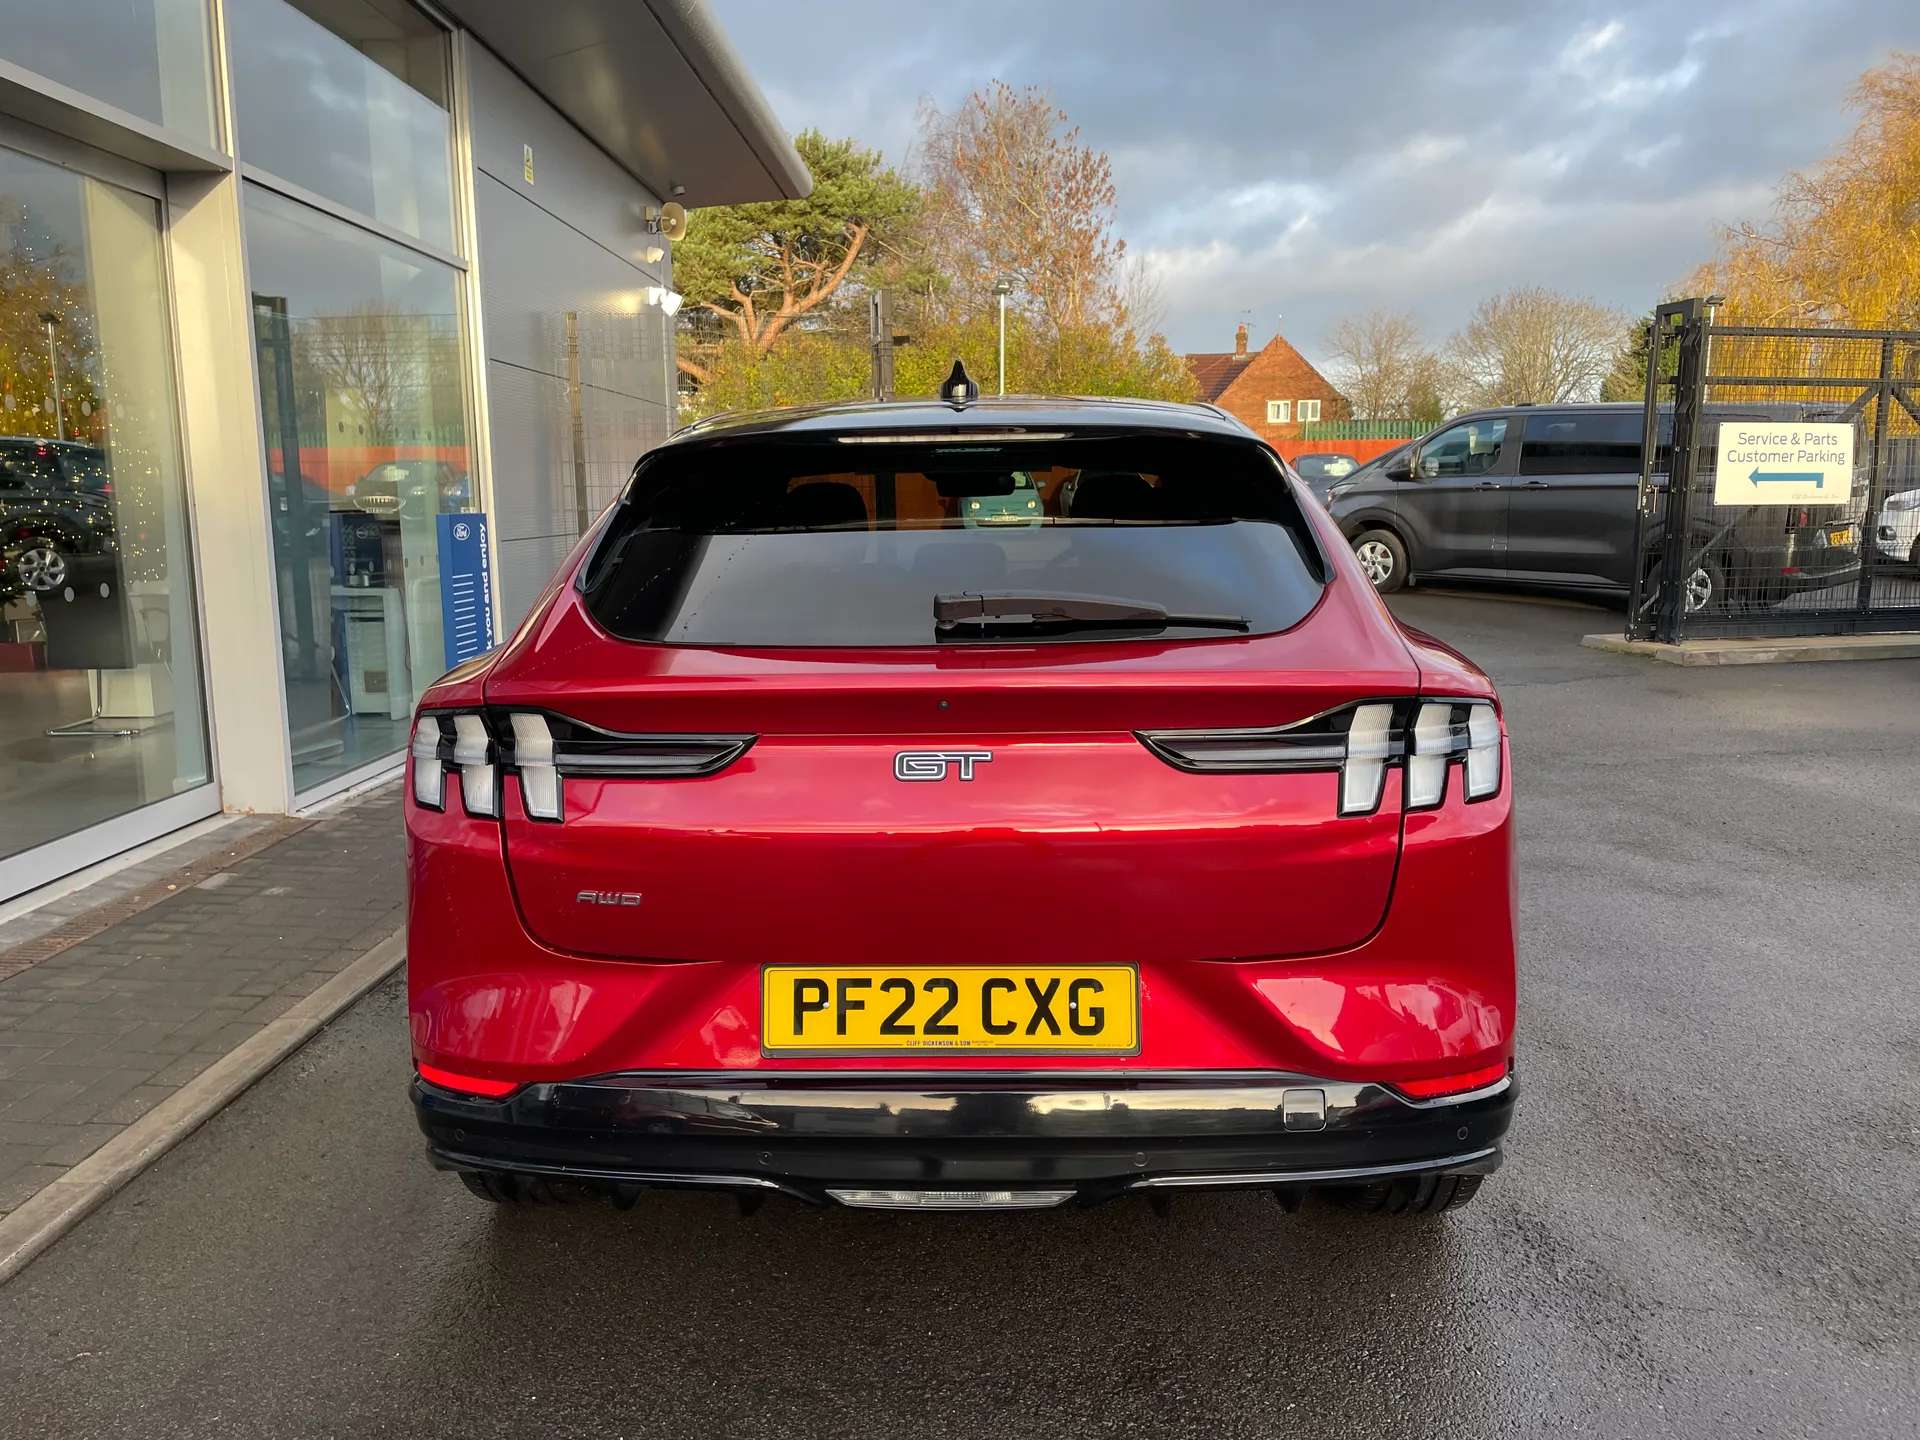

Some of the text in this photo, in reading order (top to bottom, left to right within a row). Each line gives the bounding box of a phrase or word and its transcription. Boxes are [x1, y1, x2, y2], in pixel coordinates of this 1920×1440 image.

[1738, 432, 1838, 445] Service & Parts
[1727, 449, 1845, 465] Customer Parking
[479, 523, 488, 569] enjoy
[481, 571, 490, 604] and
[484, 607, 493, 638] you
[893, 750, 993, 782] GT
[576, 889, 642, 906] AWD
[793, 977, 1105, 1036] PF22 CXG
[906, 1039, 921, 1047] CLIFF
[960, 1039, 971, 1047] SON
